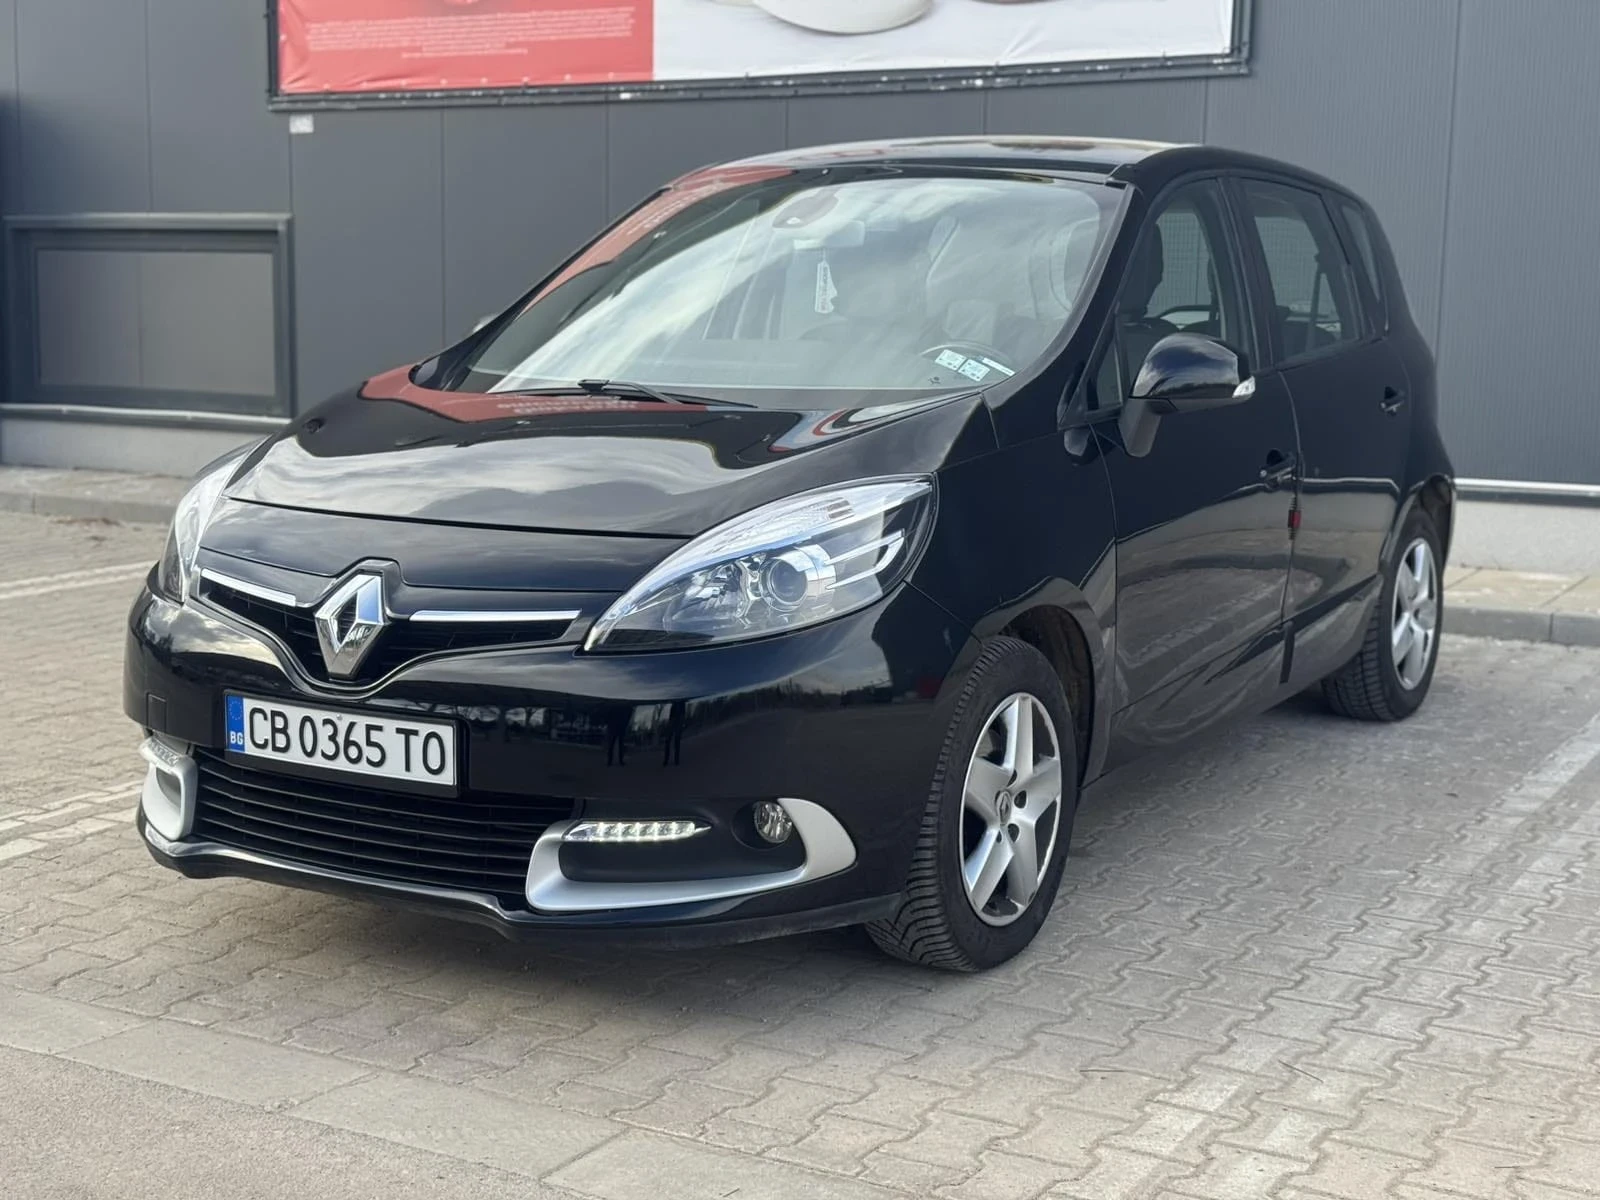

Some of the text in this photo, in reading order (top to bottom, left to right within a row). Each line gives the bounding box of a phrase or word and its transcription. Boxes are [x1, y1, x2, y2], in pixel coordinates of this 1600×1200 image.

[230, 731, 244, 745] BG
[249, 707, 446, 776] CB 0365 TO
